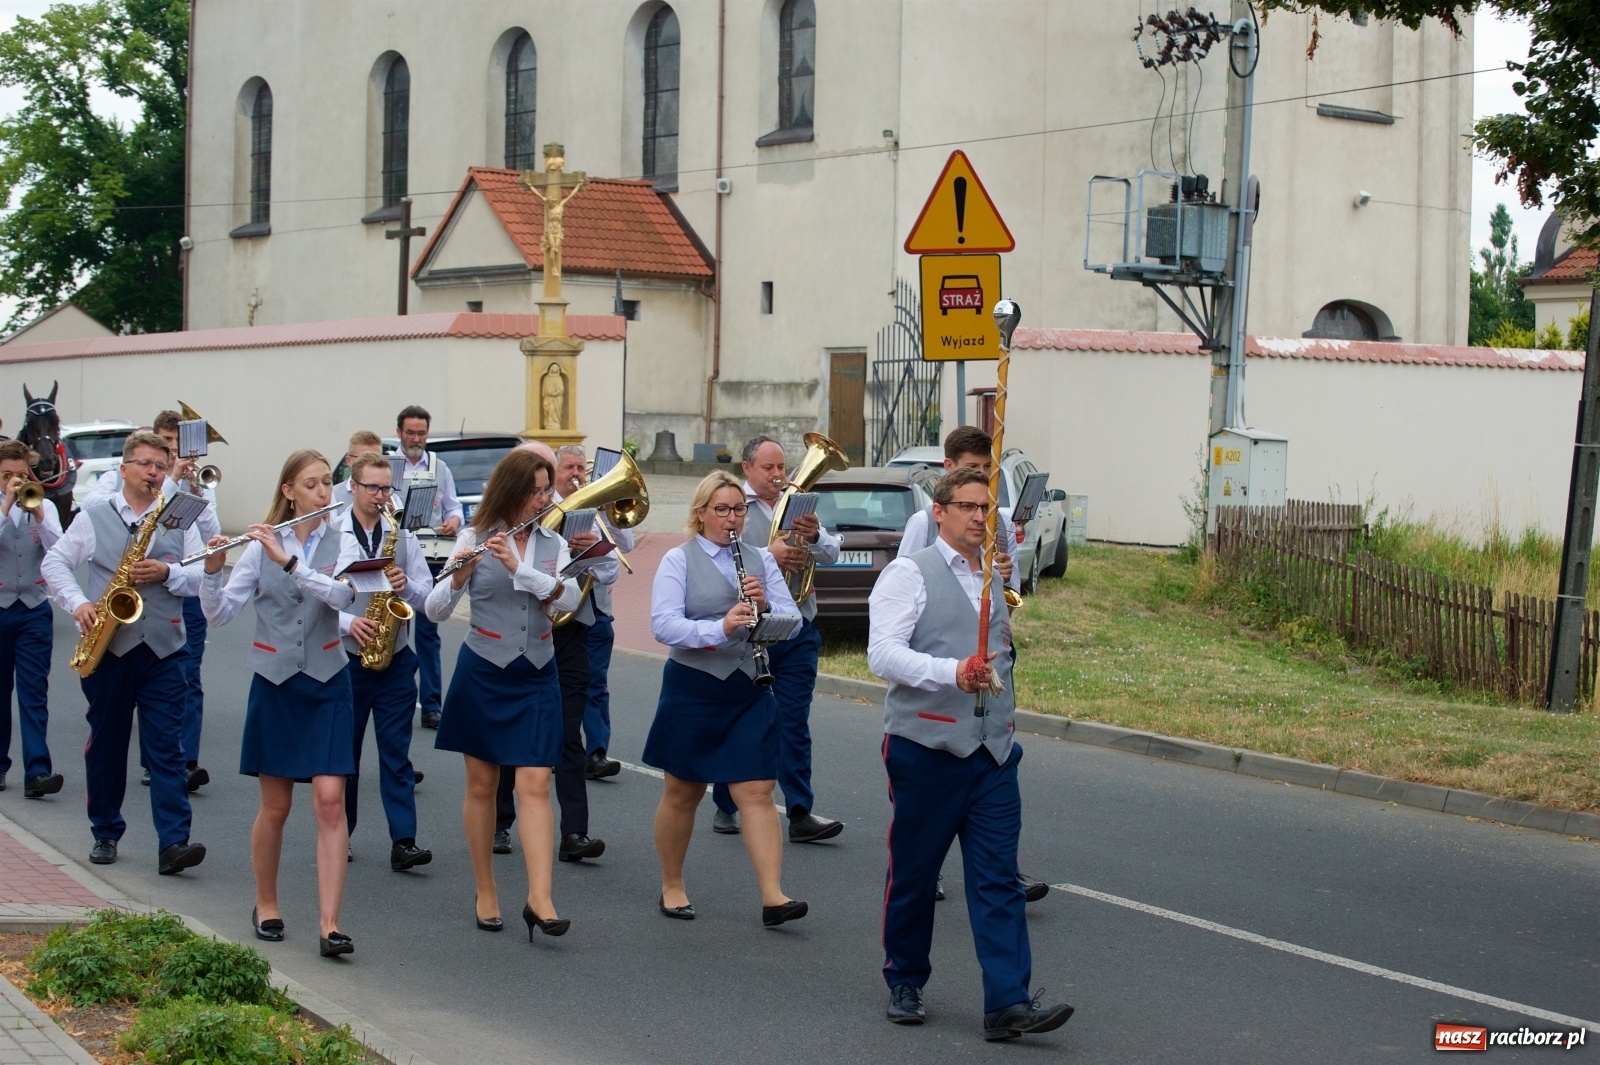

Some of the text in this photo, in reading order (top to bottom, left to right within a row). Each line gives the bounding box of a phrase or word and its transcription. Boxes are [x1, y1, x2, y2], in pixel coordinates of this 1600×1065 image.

[942, 290, 981, 306] STRAŻ
[940, 335, 985, 349] Wyjazd
[1224, 450, 1241, 462] A202
